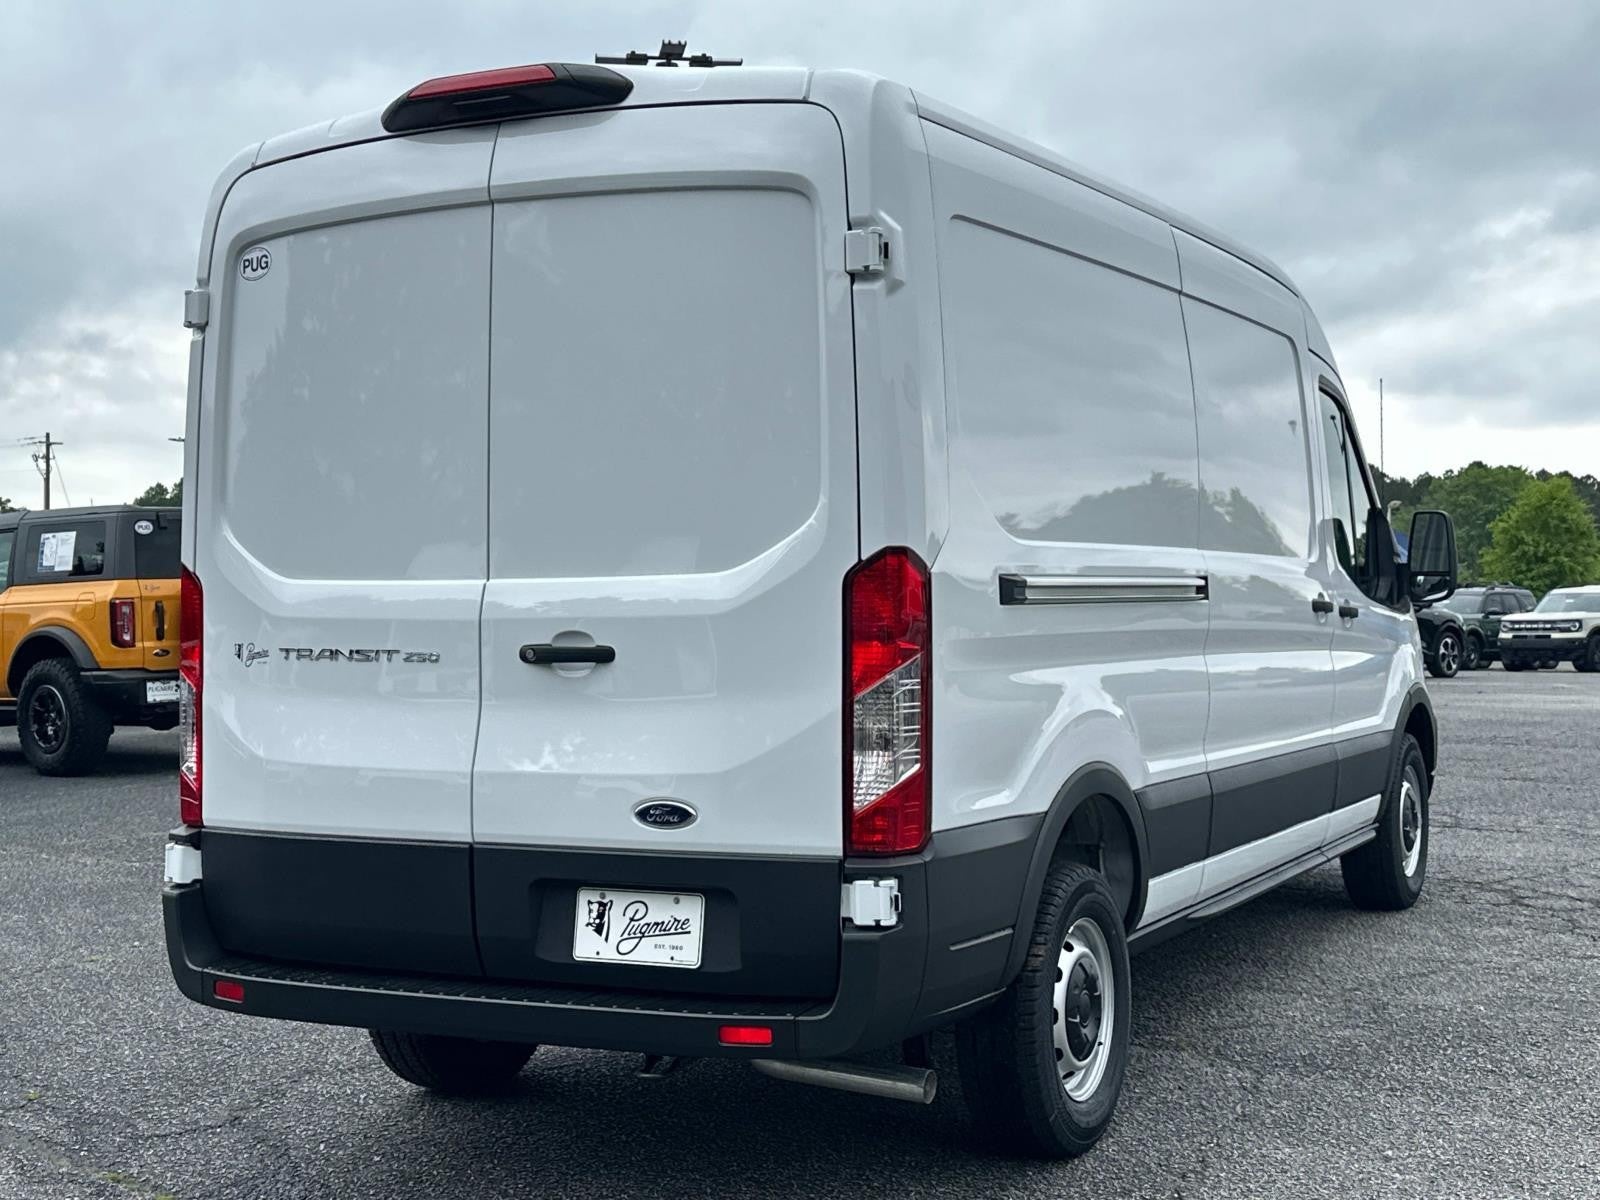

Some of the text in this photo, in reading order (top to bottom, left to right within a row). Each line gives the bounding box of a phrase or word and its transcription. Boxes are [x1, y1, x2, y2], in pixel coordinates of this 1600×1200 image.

[242, 254, 269, 275] PUG
[278, 647, 441, 664] TRANSIT 250
[616, 900, 692, 956] Pugmire
